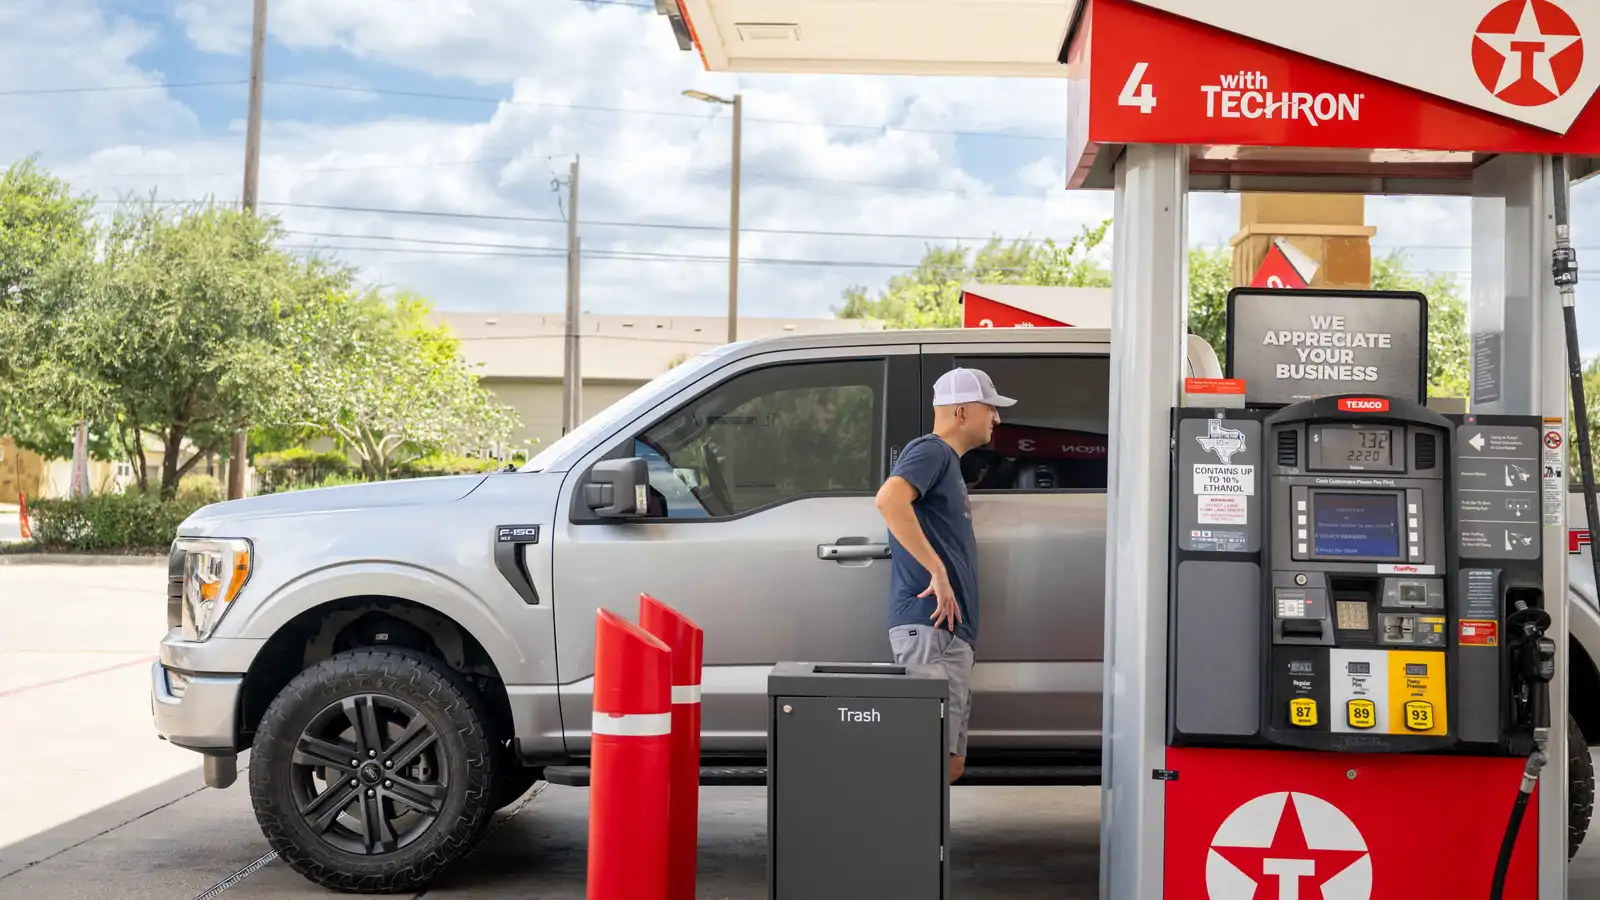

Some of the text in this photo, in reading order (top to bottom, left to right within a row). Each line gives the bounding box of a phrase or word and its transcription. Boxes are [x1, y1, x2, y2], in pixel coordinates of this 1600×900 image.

[1219, 70, 1268, 90] with
[1117, 62, 1157, 114] 4
[1200, 85, 1361, 126] TECHRON
[1310, 315, 1345, 331] WE
[1262, 331, 1392, 349] APPRECIATE
[1296, 348, 1354, 364] YOUR
[1275, 364, 1378, 381] BUSINESS
[1345, 400, 1382, 409] TEXACO
[1313, 433, 1319, 442] $
[1194, 467, 1253, 476] CONTAINS UP
[1203, 484, 1244, 492] ETHANOL
[499, 528, 535, 536] F-150
[1292, 679, 1311, 687] Regular
[837, 707, 881, 722] Trash
[1296, 706, 1312, 718] 87
[1353, 707, 1370, 719] 89
[1411, 709, 1428, 721] 93
